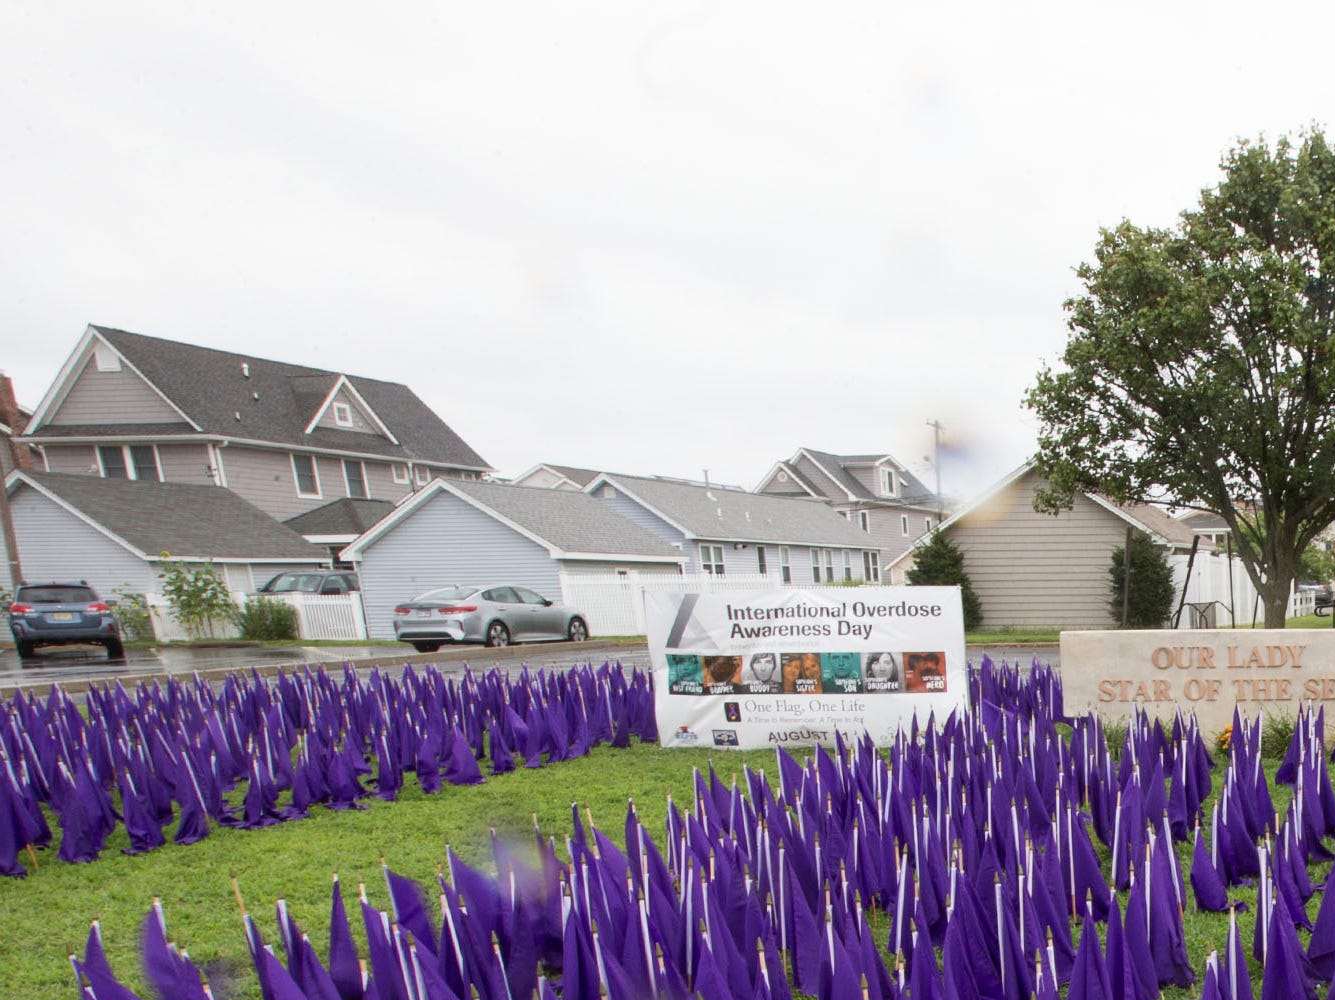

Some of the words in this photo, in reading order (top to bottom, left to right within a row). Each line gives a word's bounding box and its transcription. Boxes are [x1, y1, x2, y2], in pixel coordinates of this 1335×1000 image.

[726, 602, 846, 620] International
[852, 601, 942, 617] Overdose
[730, 622, 832, 639] Awareness
[837, 620, 873, 640] Day
[1151, 646, 1216, 670] OUR
[1227, 645, 1307, 669] LADY
[1098, 679, 1174, 702] STAR
[1184, 678, 1222, 702] OF
[1231, 679, 1292, 702] THE
[744, 699, 772, 712] One
[776, 699, 805, 716] Flag,
[809, 699, 837, 712] One
[841, 699, 866, 712] Life
[768, 730, 829, 743] AUGUST
